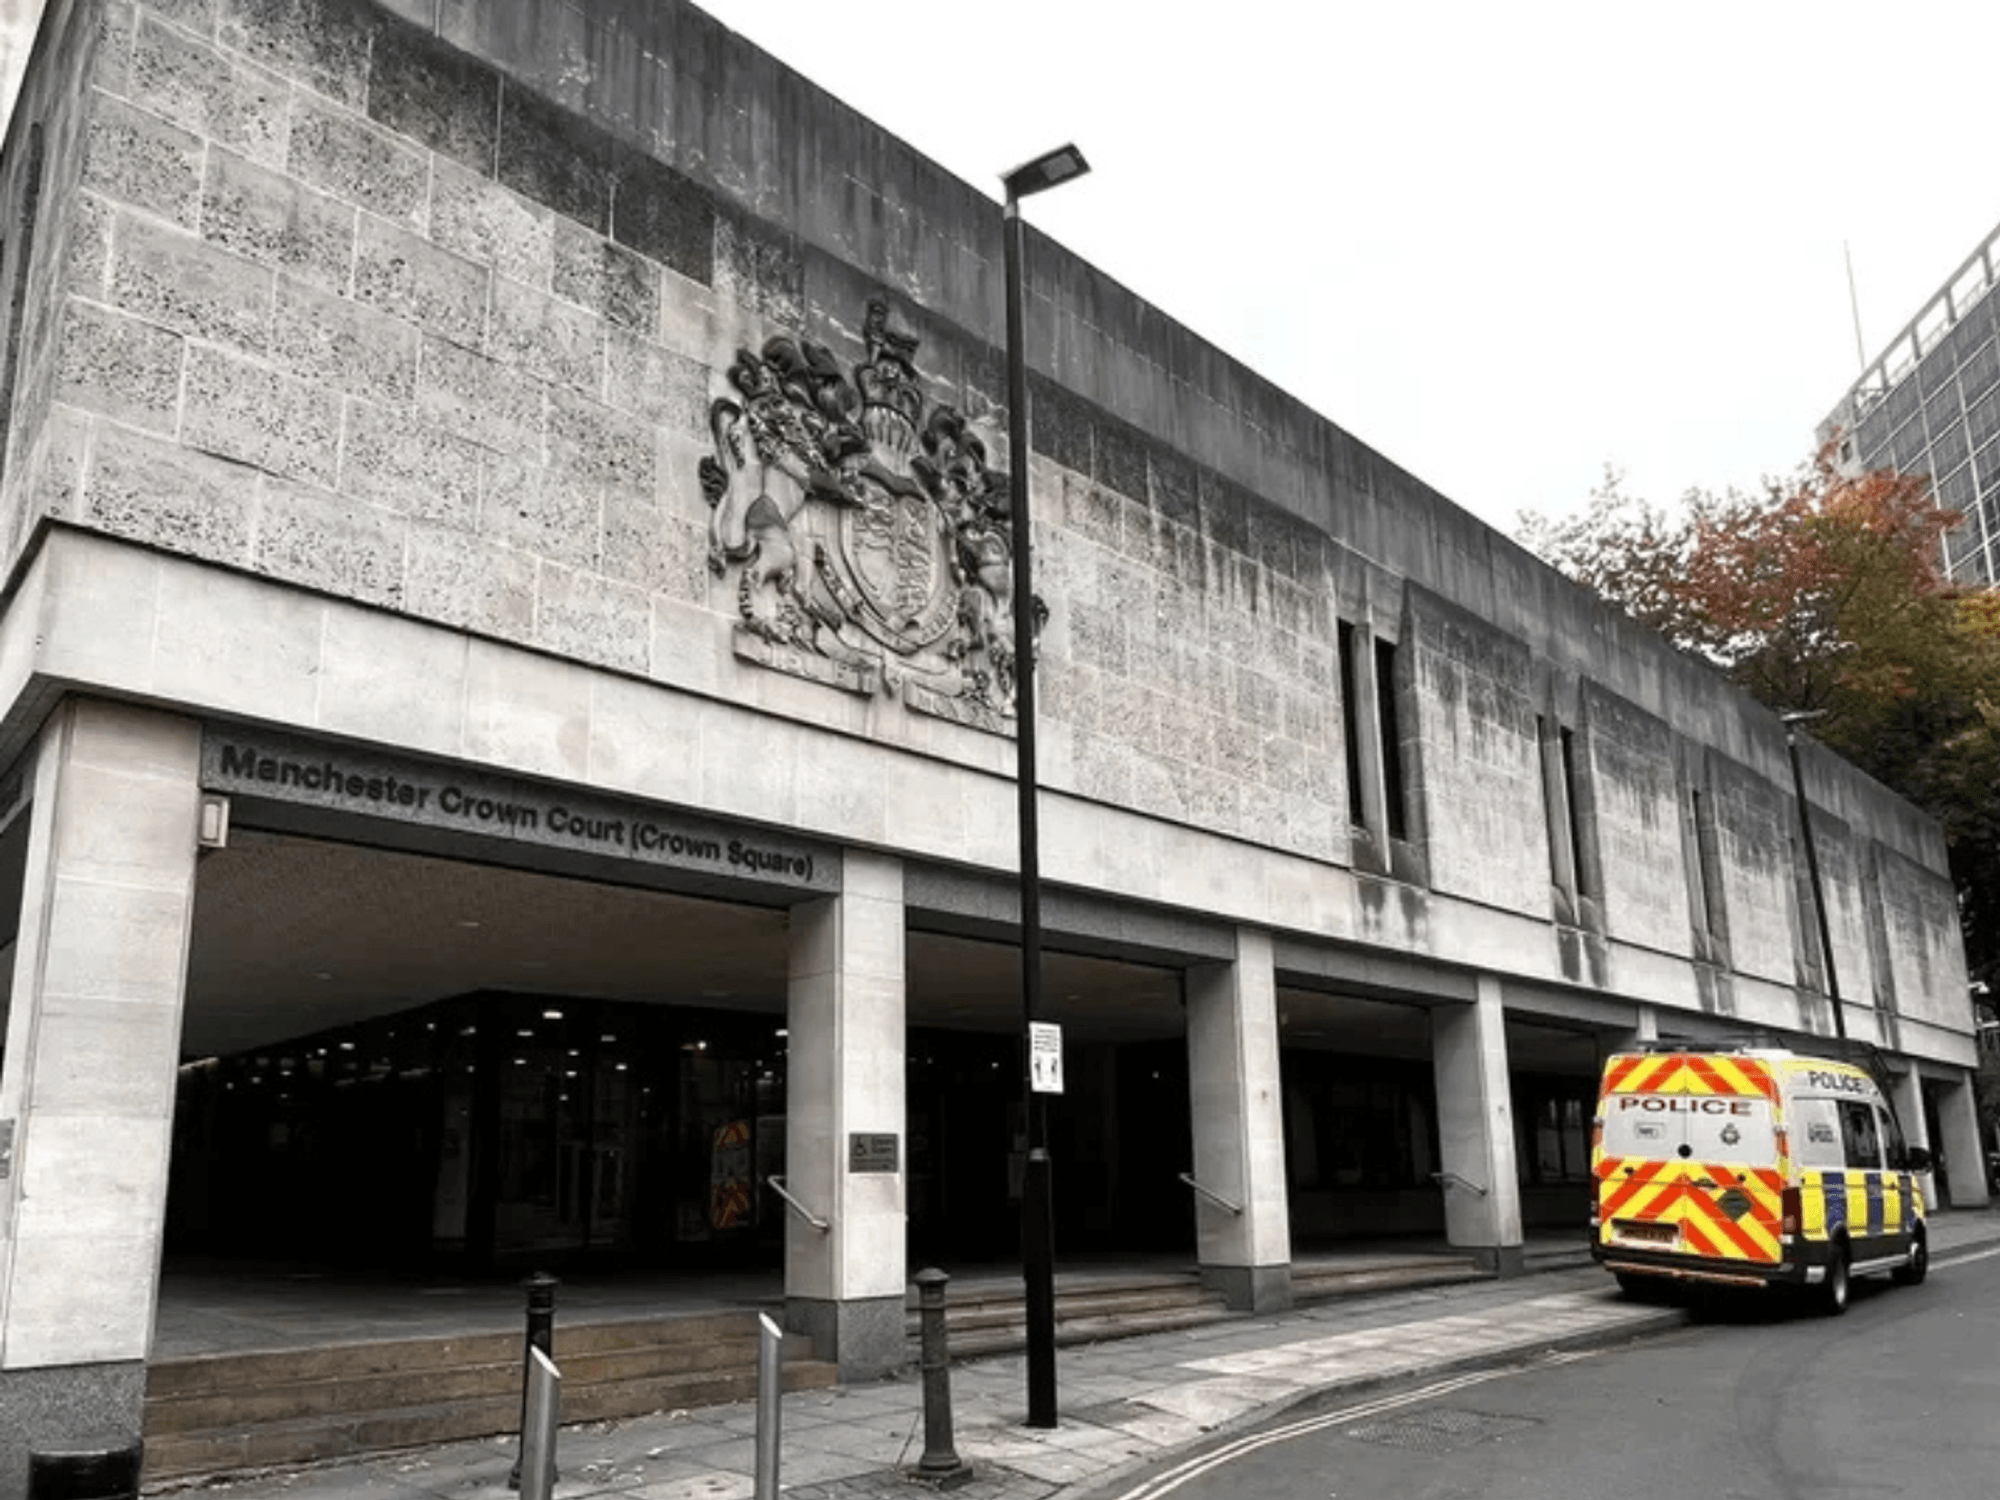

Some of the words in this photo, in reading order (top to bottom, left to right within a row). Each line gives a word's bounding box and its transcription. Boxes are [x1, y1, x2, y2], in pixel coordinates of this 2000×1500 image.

[220, 745, 430, 809] Manchester
[438, 787, 538, 828] Crown
[547, 806, 625, 843] Court
[632, 822, 721, 859] (Crown
[727, 840, 814, 881] Square)
[1809, 1071, 1863, 1094] POLICE
[1619, 1097, 1752, 1116] POLICE
